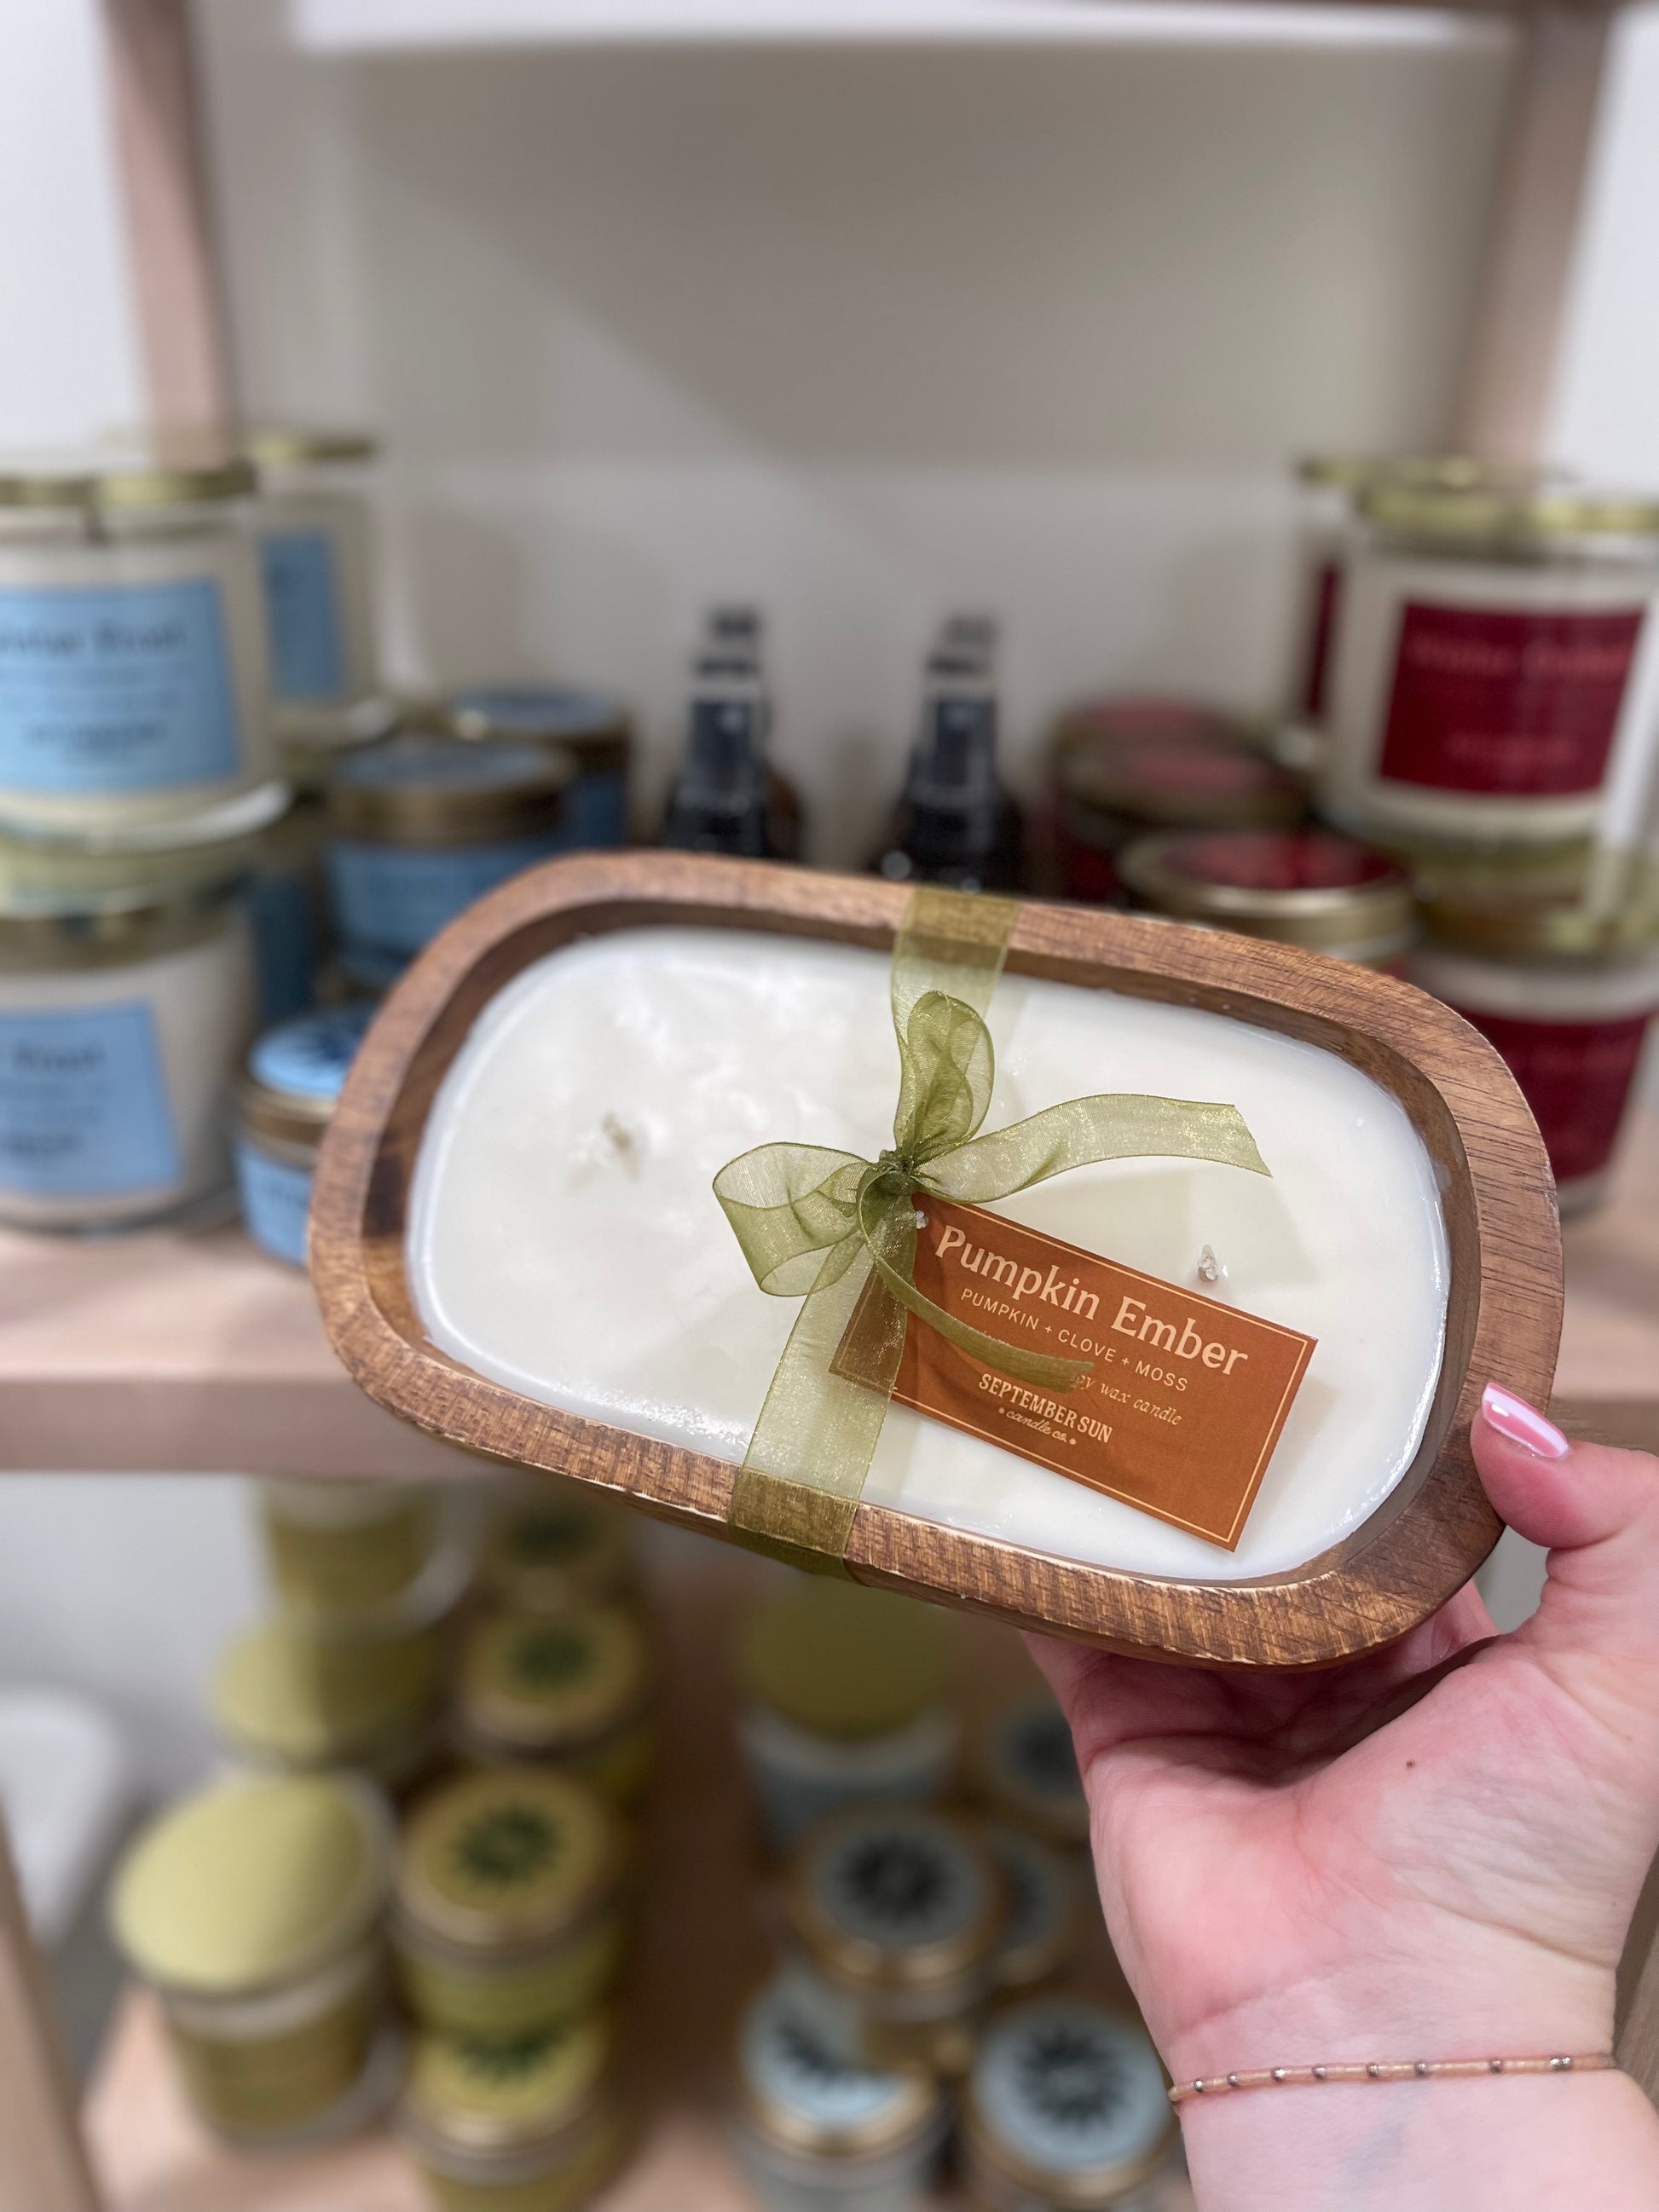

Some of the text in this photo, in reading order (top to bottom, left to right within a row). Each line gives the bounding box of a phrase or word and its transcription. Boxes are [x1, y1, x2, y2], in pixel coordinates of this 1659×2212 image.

[934, 1224, 1249, 1375] Pumpkin Ember
[961, 1288, 1040, 1331] PUMPKIN
[1058, 1329, 1117, 1362] CLOVE
[1135, 1360, 1188, 1391] MOSS
[979, 1373, 1113, 1443] SEPTEMBER SUN
[1006, 1411, 1052, 1435] candle
[1101, 1383, 1131, 1404] wax
[1133, 1399, 1182, 1425] candle
